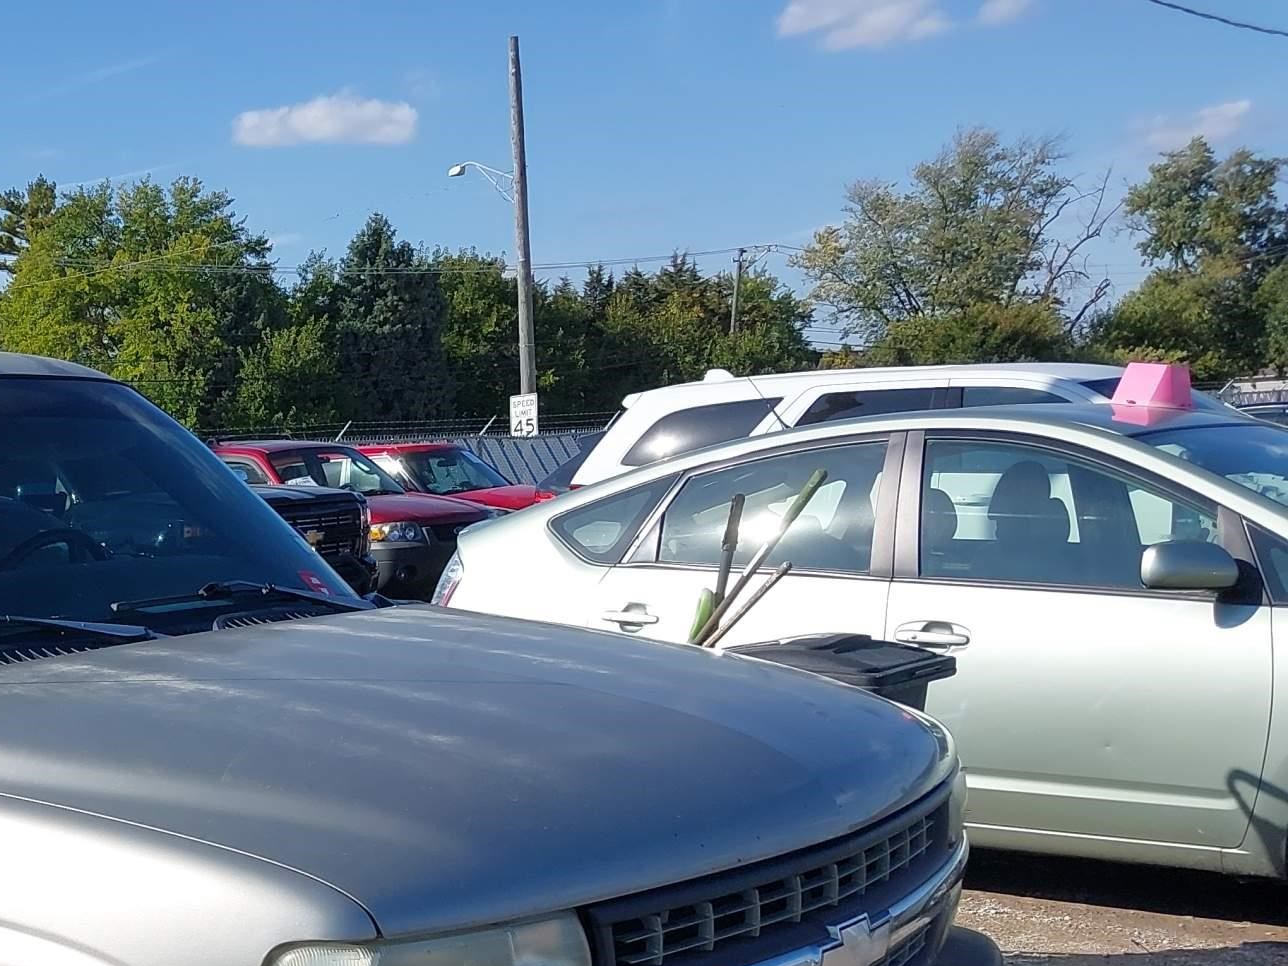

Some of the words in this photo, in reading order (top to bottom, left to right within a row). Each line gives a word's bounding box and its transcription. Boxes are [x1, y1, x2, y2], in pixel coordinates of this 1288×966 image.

[512, 399, 535, 408] SPEED
[514, 408, 533, 418] LIMIT
[513, 418, 535, 434] 45
